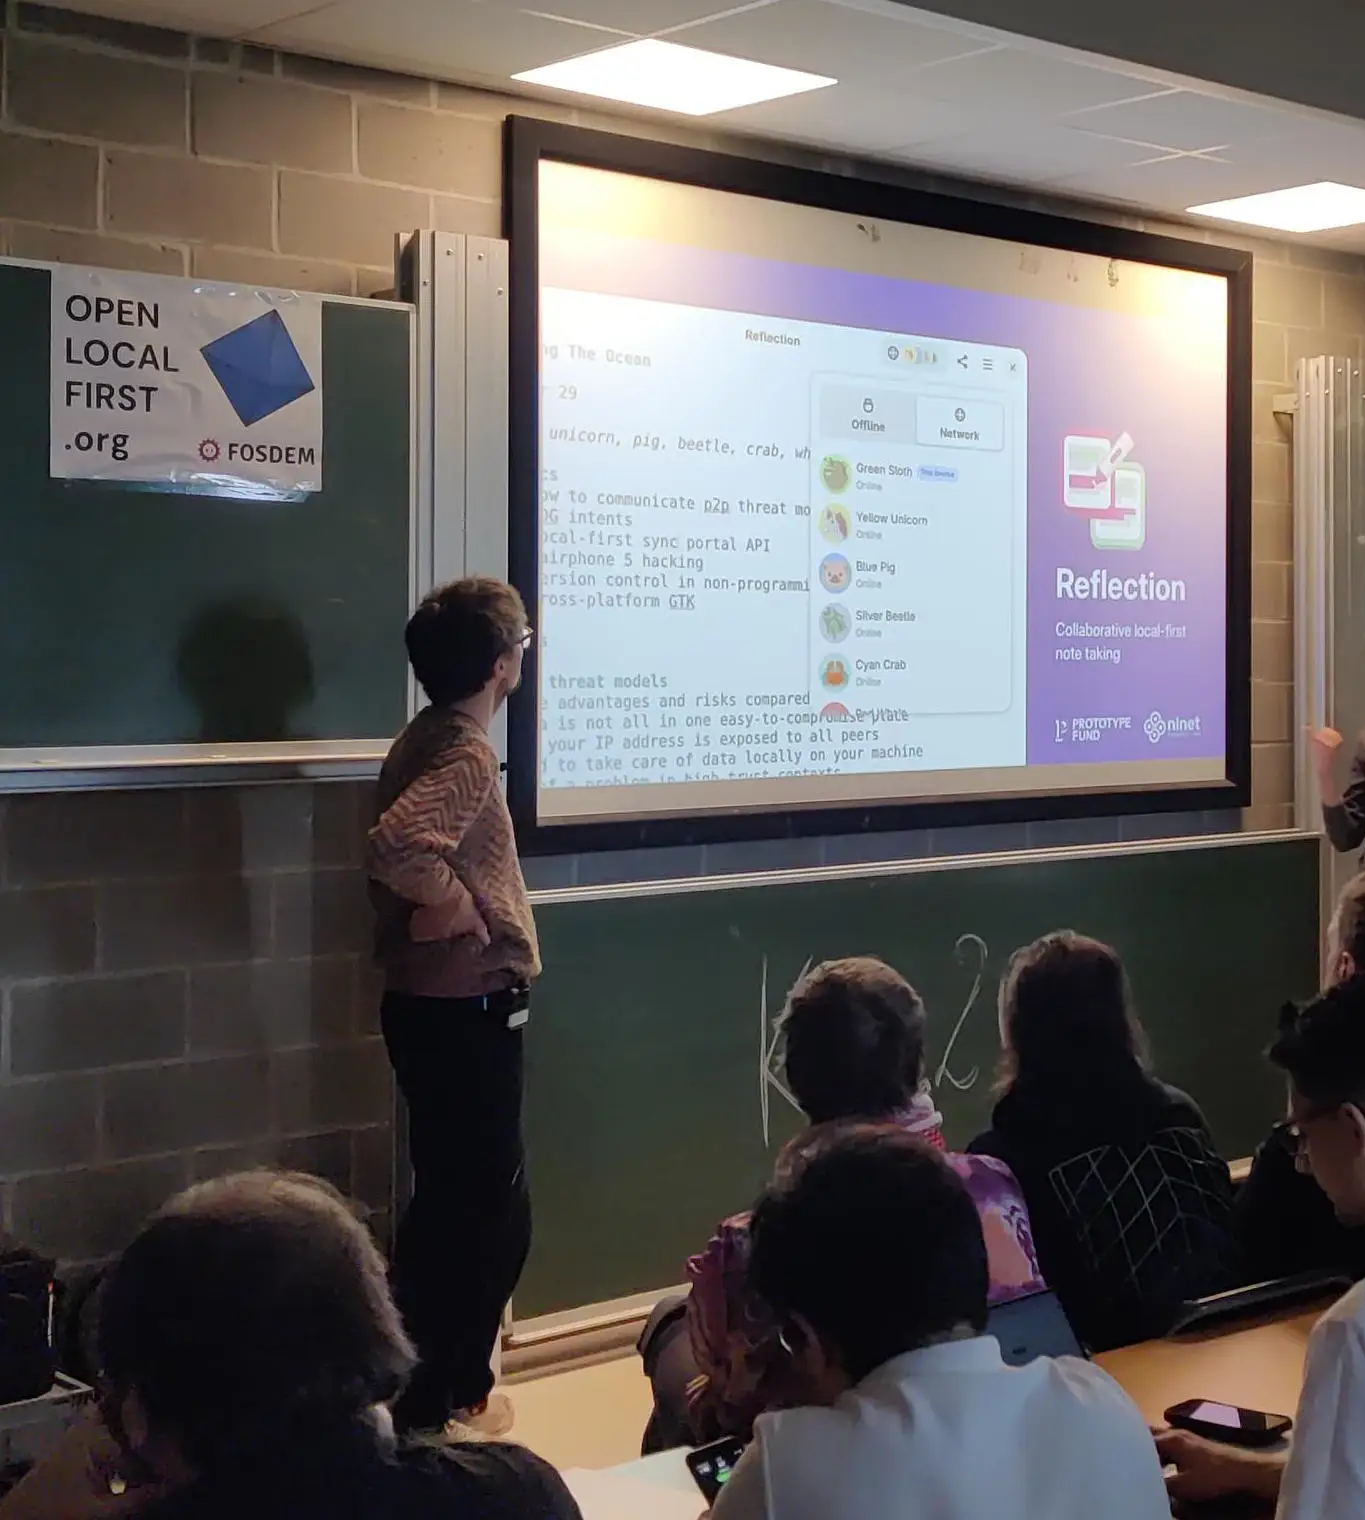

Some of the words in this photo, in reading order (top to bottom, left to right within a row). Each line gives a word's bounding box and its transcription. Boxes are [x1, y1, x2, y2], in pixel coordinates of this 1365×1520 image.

[65, 294, 160, 329] OPEN
[745, 328, 802, 347] Reflection
[65, 337, 180, 373] LOCAL
[568, 344, 597, 362] The
[605, 349, 652, 368] Ocean
[65, 380, 159, 413] FIRST
[558, 384, 579, 400] 29
[851, 418, 886, 433] Offline
[939, 427, 980, 442] Network
[65, 431, 130, 462] .org
[549, 426, 622, 447] unicorn,
[632, 432, 667, 451] pig,
[677, 435, 736, 455] beetle,
[746, 441, 786, 460] crab,
[794, 446, 812, 460] wh
[227, 442, 316, 466] FOSDEM
[856, 462, 886, 477] Green
[888, 464, 914, 479] Sloth
[568, 488, 588, 504] to
[597, 492, 696, 511] communicate
[704, 497, 730, 514] p2p
[738, 500, 787, 516] threat
[794, 503, 812, 517] mo
[568, 507, 633, 527] intents
[856, 511, 888, 525] Yellow
[890, 513, 928, 526] Unicorn
[643, 533, 678, 551] sync
[686, 534, 737, 552] portal
[746, 537, 771, 552] API
[623, 554, 633, 568] 5
[642, 553, 704, 572] hacking
[856, 560, 878, 573] Blue
[880, 561, 896, 575] Pig
[605, 573, 668, 588] control
[679, 573, 696, 588] in
[1055, 566, 1187, 602] Reflection
[668, 594, 696, 610] GTK
[856, 610, 884, 622] Silver
[886, 611, 916, 623] Beetle
[1055, 621, 1132, 639] Collaborative
[1133, 622, 1187, 639] local-first
[1055, 647, 1083, 661] note
[1085, 646, 1122, 664] taking
[856, 659, 881, 673] Cyan
[883, 659, 907, 671] Crab
[549, 674, 605, 690] threat
[614, 673, 669, 689] models
[558, 694, 650, 712] advantages
[659, 693, 686, 708] and
[695, 691, 737, 707] risks
[745, 690, 811, 710] compared
[558, 714, 577, 731] is
[586, 715, 614, 731] not
[623, 712, 650, 729] all
[660, 711, 677, 728] in
[686, 713, 712, 727] one
[1072, 716, 1132, 730] PROTOTYPE
[548, 736, 586, 755] your
[596, 735, 614, 751] IP
[622, 732, 685, 750] address
[694, 731, 711, 748] is
[719, 730, 779, 749] exposed
[787, 729, 803, 745] to
[809, 727, 833, 744] all
[841, 728, 880, 748] peers
[1071, 729, 1101, 742] FUND
[558, 757, 577, 772] to
[586, 755, 623, 772] take
[632, 753, 668, 769] care
[676, 751, 694, 767] of
[702, 750, 737, 766] data
[745, 748, 802, 767] locally
[809, 747, 826, 762] on
[833, 747, 866, 764] your
[871, 743, 925, 760] machine
